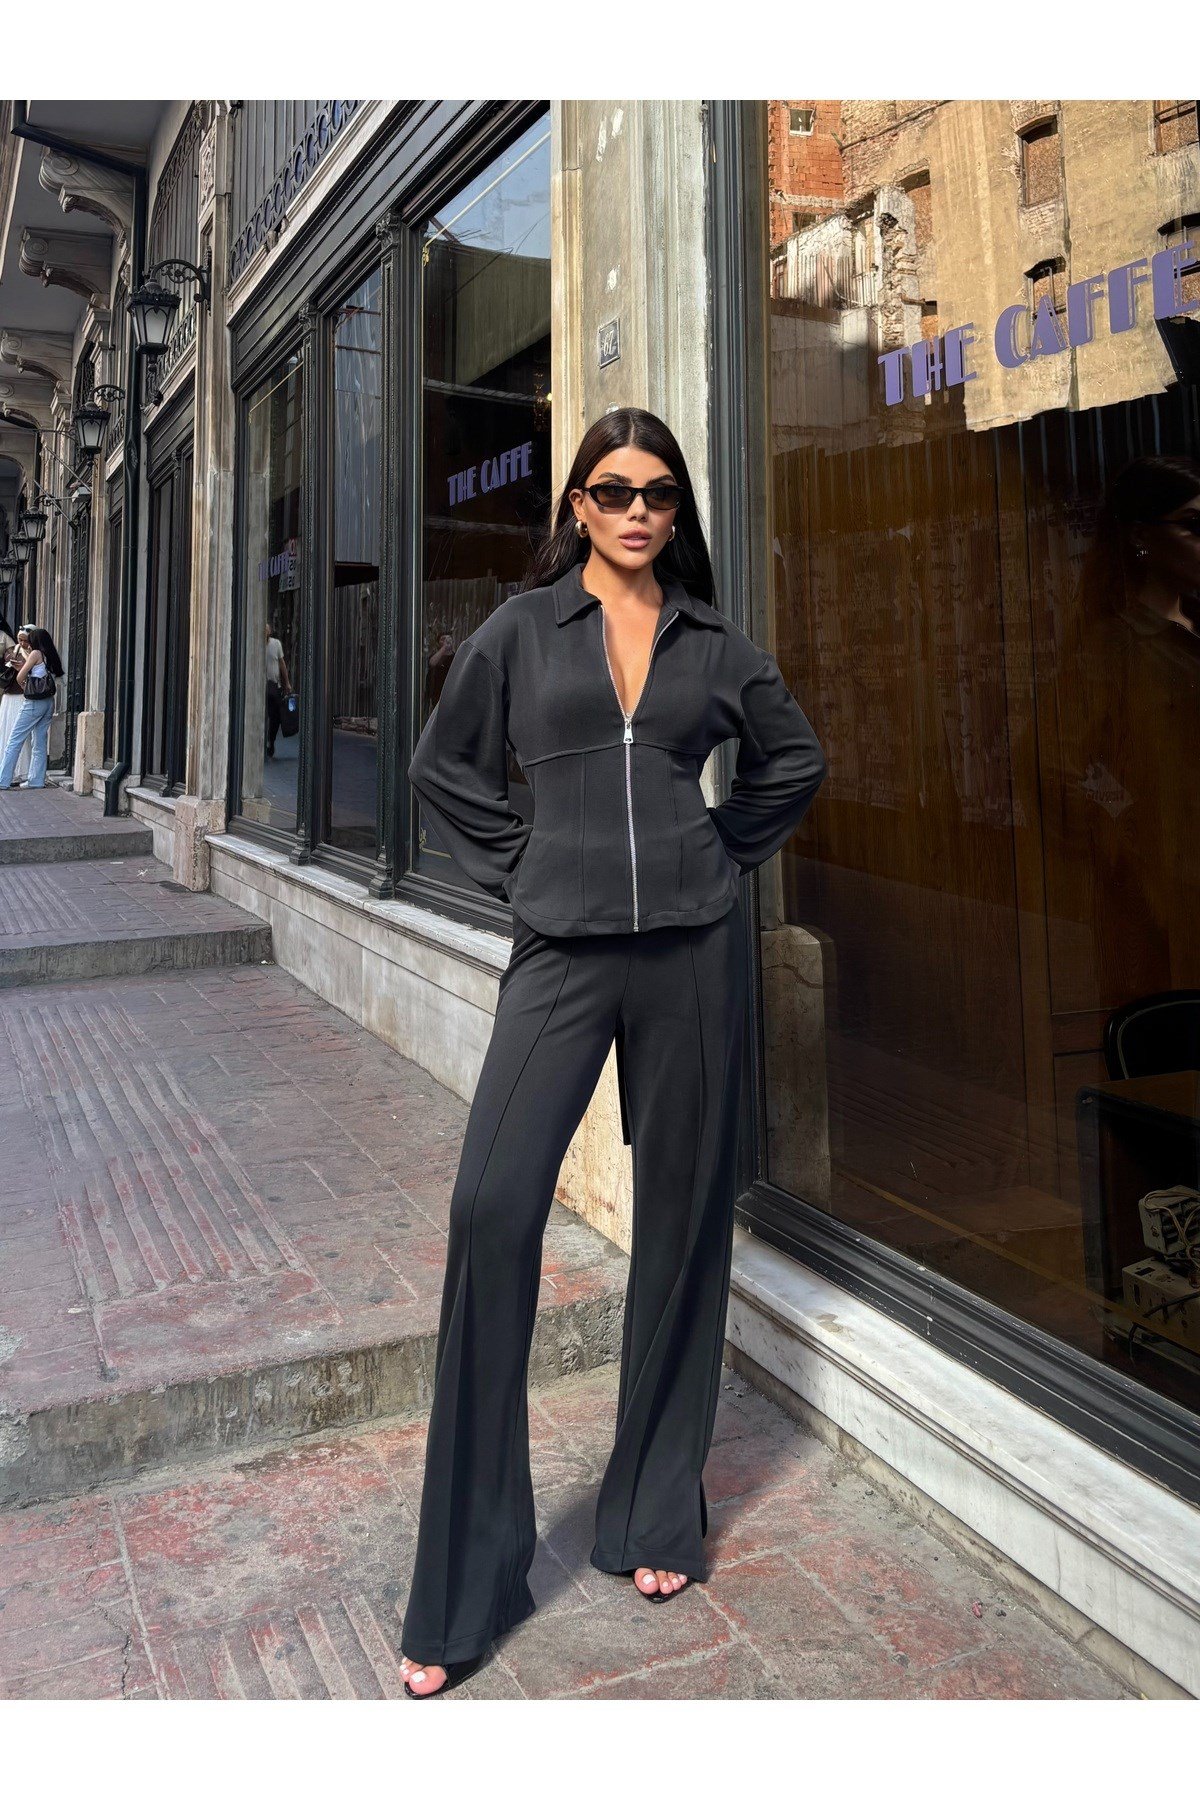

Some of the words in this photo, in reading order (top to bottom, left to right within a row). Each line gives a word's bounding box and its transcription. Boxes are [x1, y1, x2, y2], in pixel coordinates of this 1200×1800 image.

[877, 321, 978, 407] THE
[993, 239, 1200, 369] CAFFE
[447, 465, 477, 507] THE
[480, 440, 533, 494] CAFFE
